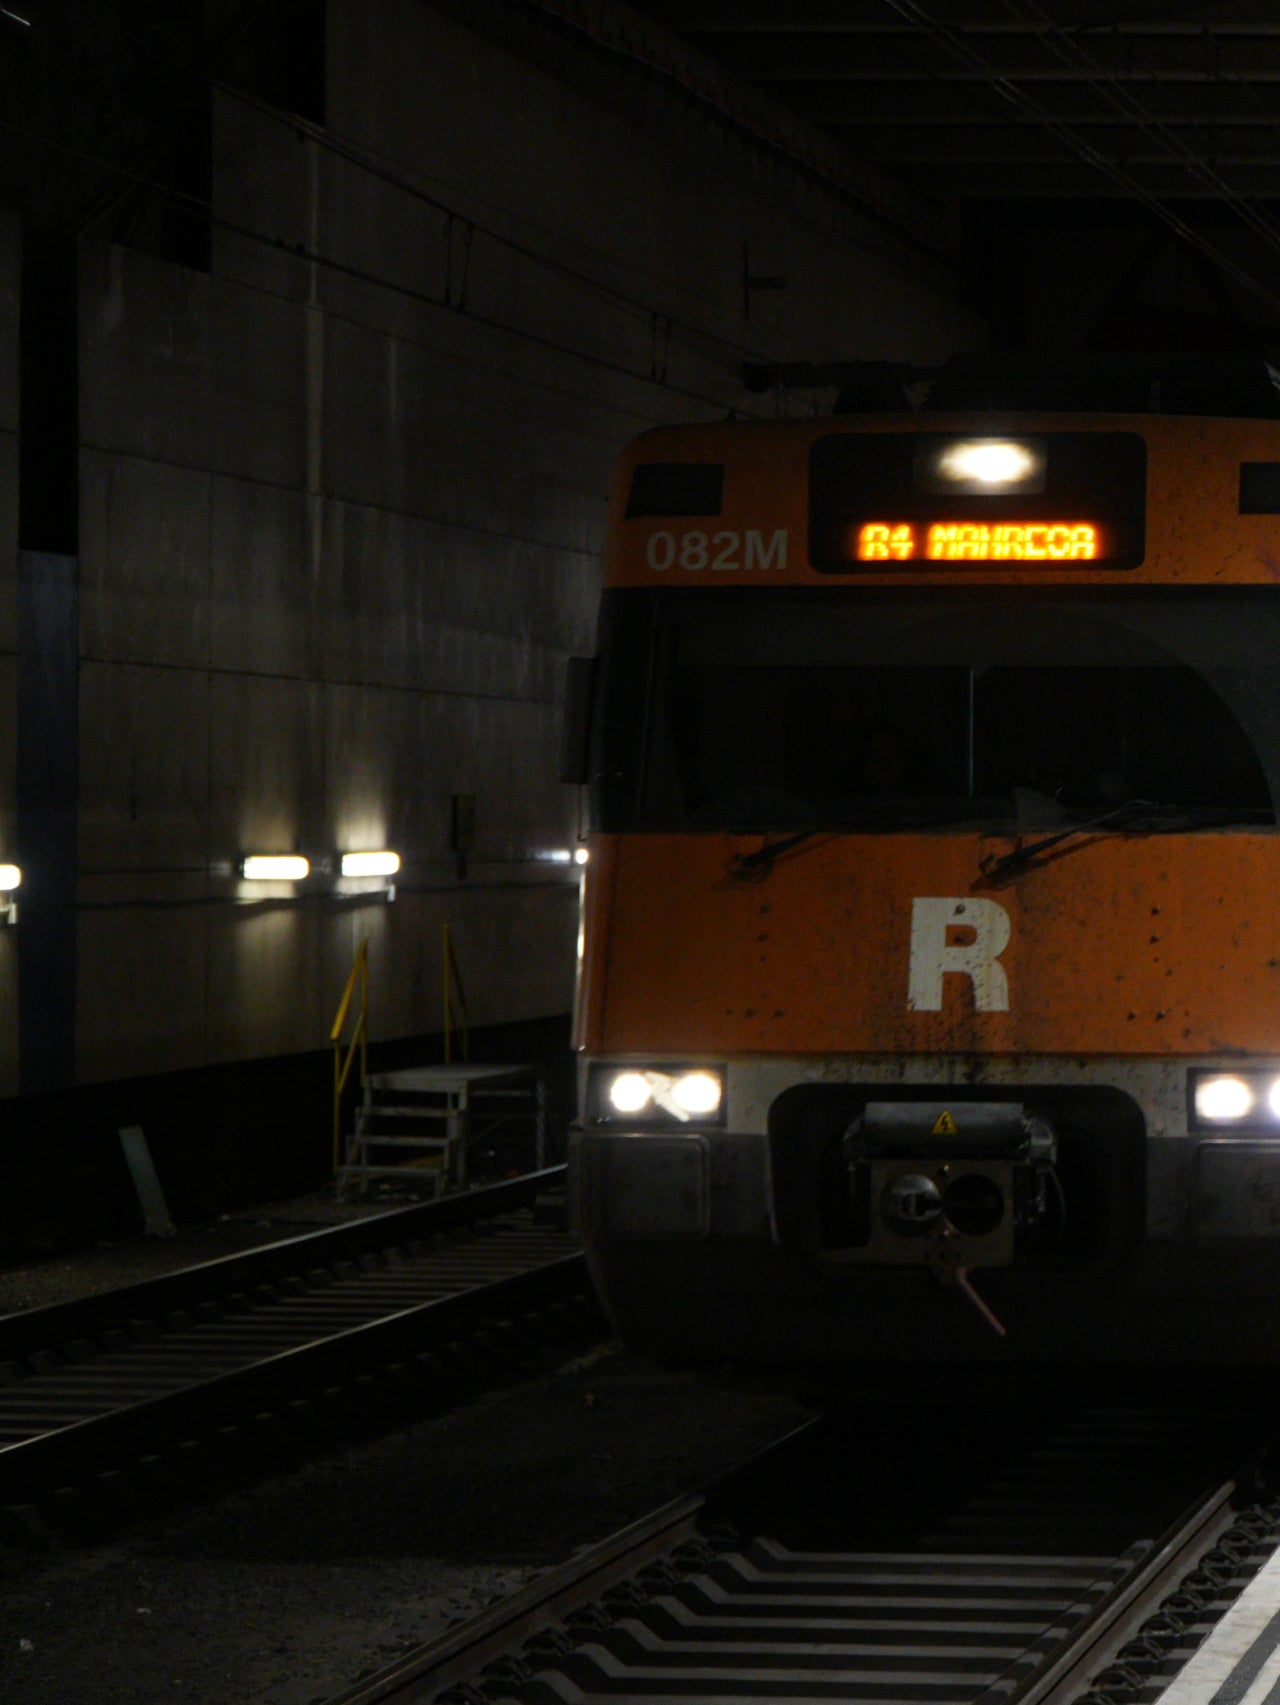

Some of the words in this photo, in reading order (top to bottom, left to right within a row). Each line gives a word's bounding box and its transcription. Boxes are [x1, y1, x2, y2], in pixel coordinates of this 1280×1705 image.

[646, 528, 789, 571] 082M
[862, 524, 914, 558] R4
[906, 896, 1012, 1012] R
